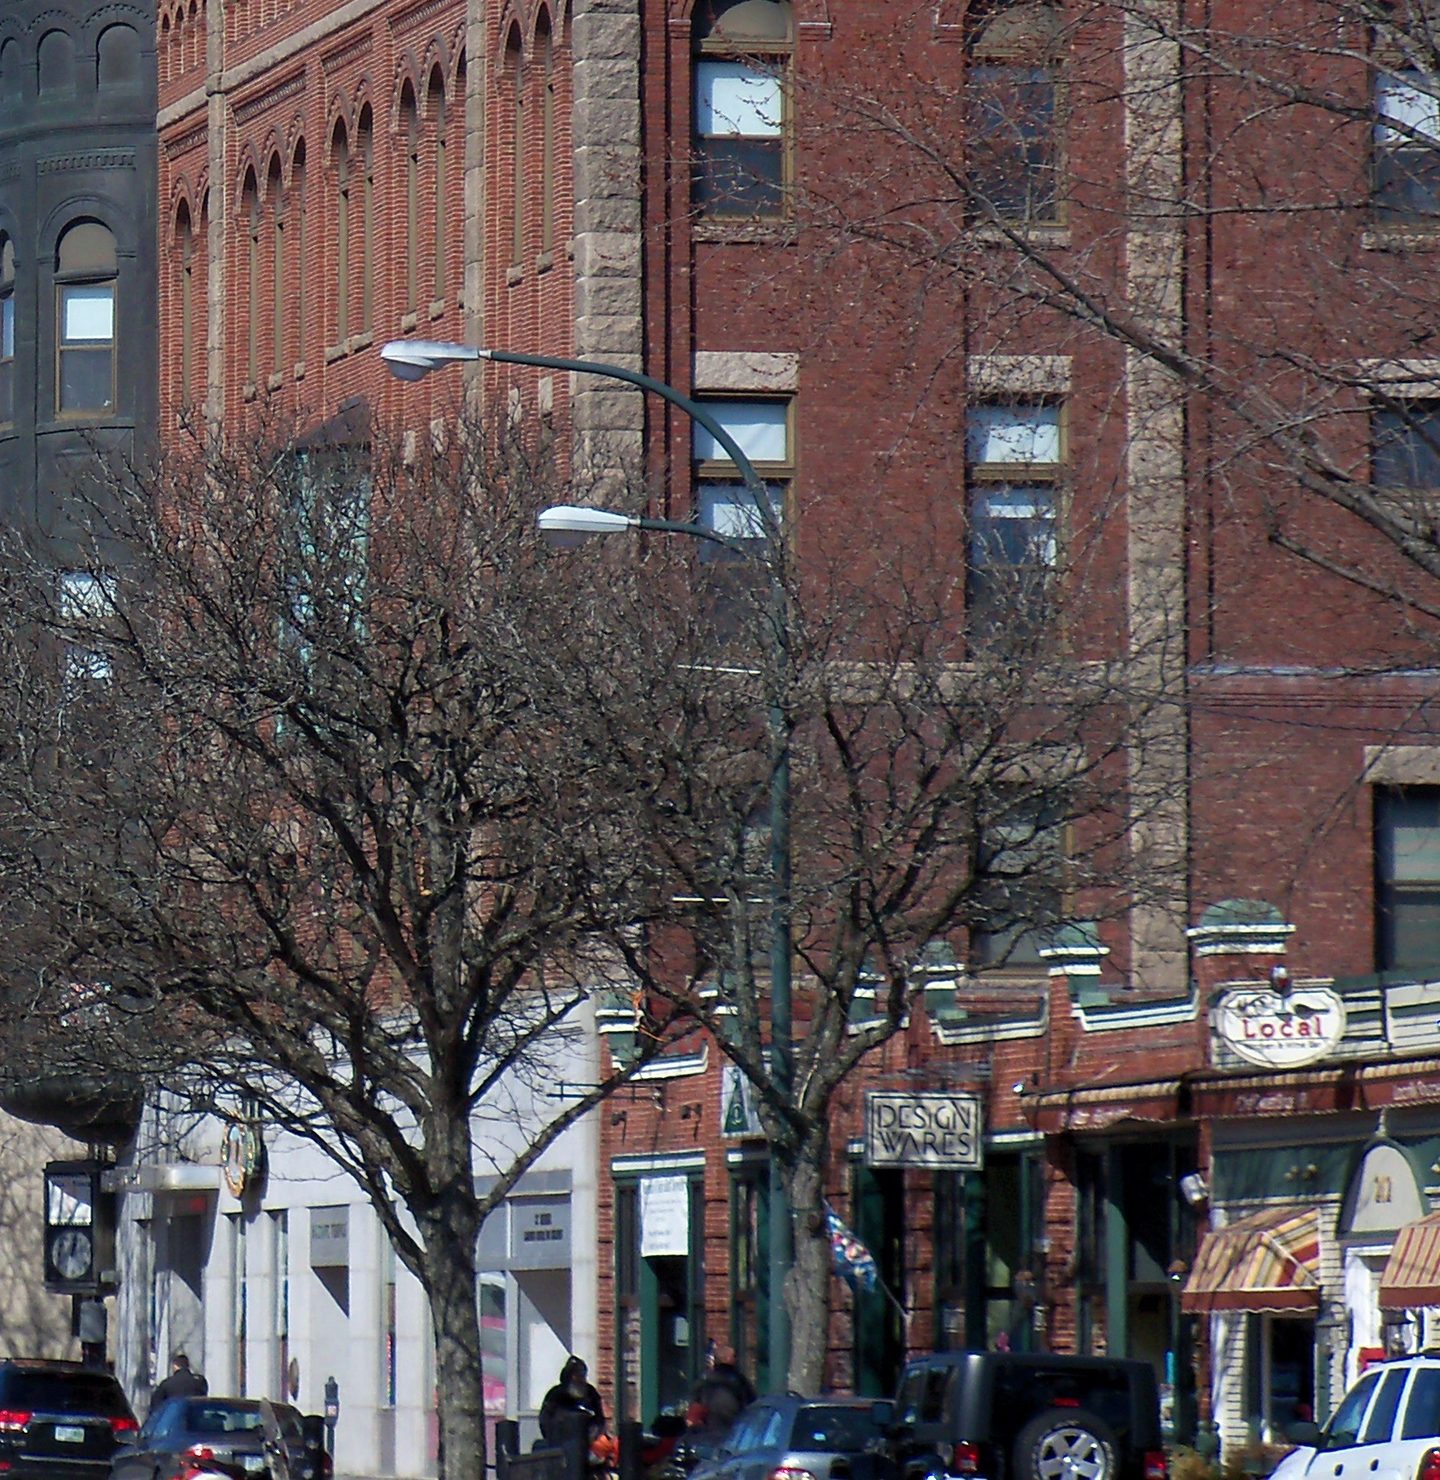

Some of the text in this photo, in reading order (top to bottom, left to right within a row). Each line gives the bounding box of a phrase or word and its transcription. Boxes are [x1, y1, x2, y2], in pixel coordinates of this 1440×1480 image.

[1242, 1016, 1323, 1038] Local
[877, 1100, 972, 1130] DESIGN
[878, 1131, 971, 1156] WARES
